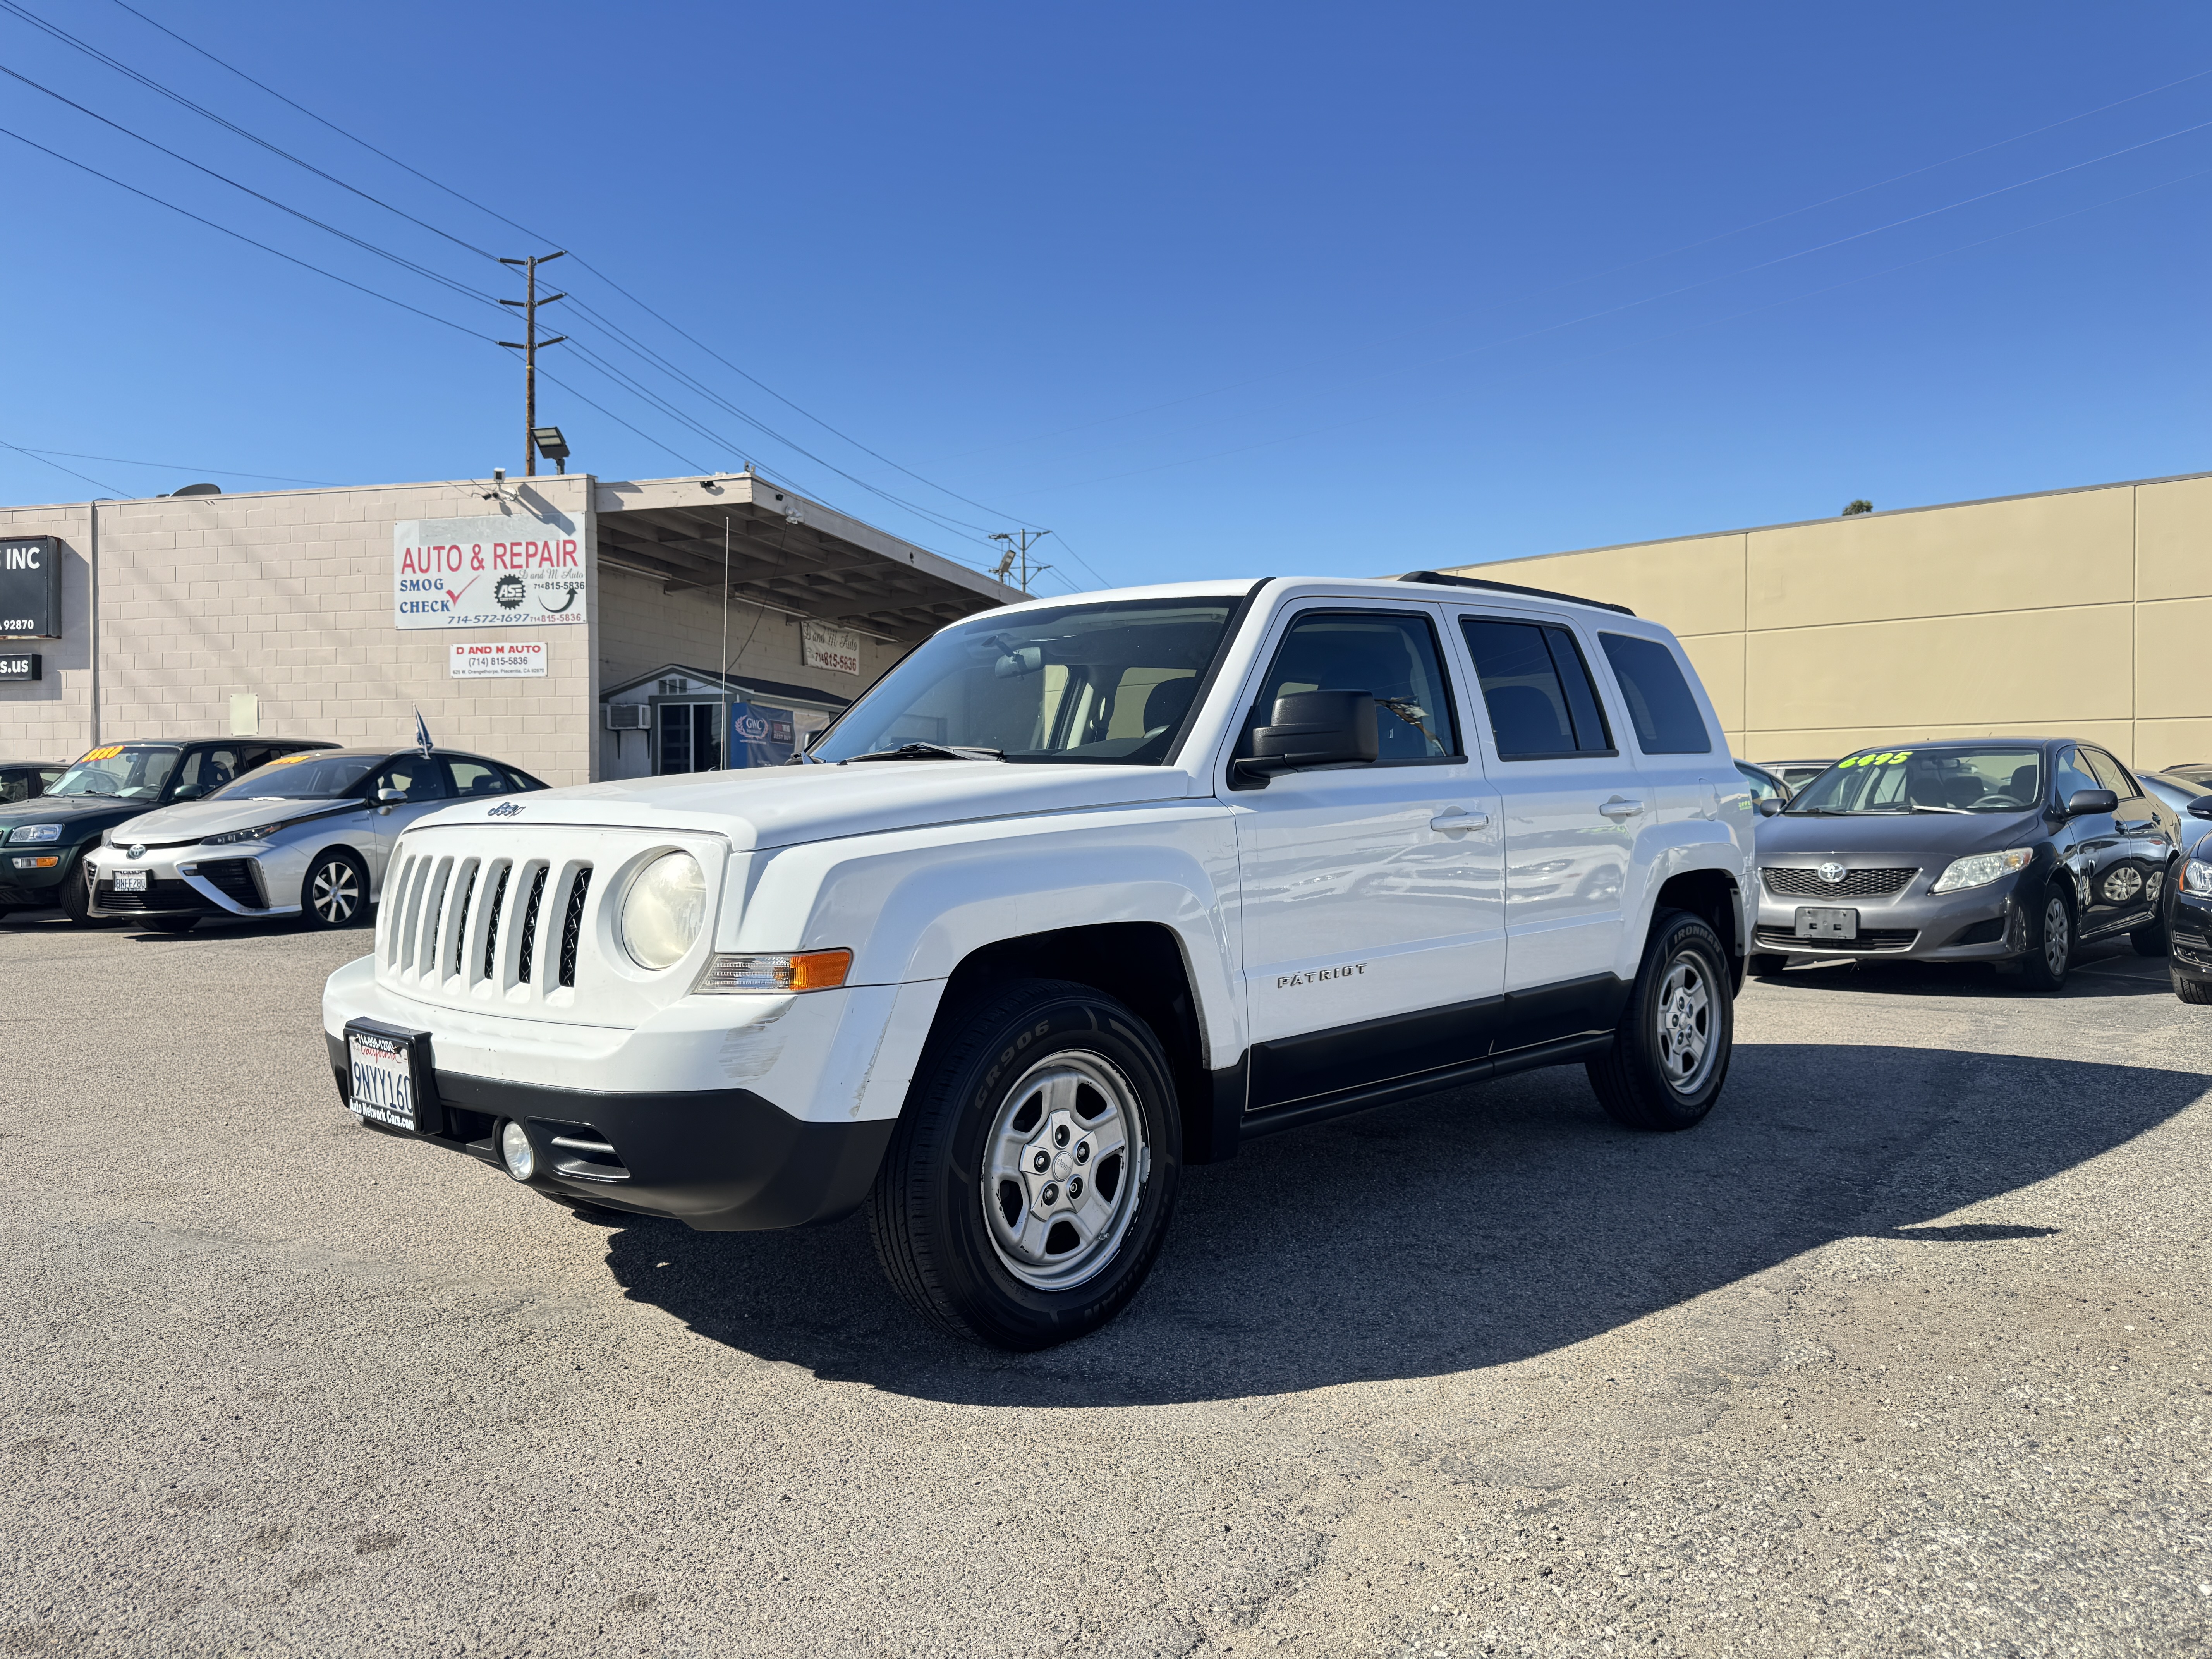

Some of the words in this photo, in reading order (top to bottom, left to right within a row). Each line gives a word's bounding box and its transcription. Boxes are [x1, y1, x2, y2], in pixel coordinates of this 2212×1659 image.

[7, 547, 40, 569] INC
[401, 544, 462, 574] AUTO
[471, 544, 485, 571] &
[493, 539, 578, 570] REPAIR
[530, 569, 544, 579] and
[561, 568, 584, 579] Auto
[400, 578, 444, 592] SMOG
[498, 584, 522, 598] ASE
[400, 600, 450, 613] CHECK
[4, 620, 34, 630] 92870
[448, 613, 530, 624] 714-572-1697
[840, 632, 857, 651] Auto
[468, 646, 492, 654] AND
[508, 645, 541, 653] AUTO
[469, 657, 489, 667] (714)
[491, 657, 528, 665] 815-5836
[746, 718, 763, 730] GWC
[1674, 926, 1720, 953] IRONMAN
[1277, 963, 1368, 989] PATRIOT
[974, 1019, 1049, 1109] GR906
[354, 1061, 413, 1113] 9NYY160
[350, 1098, 362, 1113] Auto
[362, 1102, 386, 1122] Network
[386, 1110, 414, 1131] Cars.com
